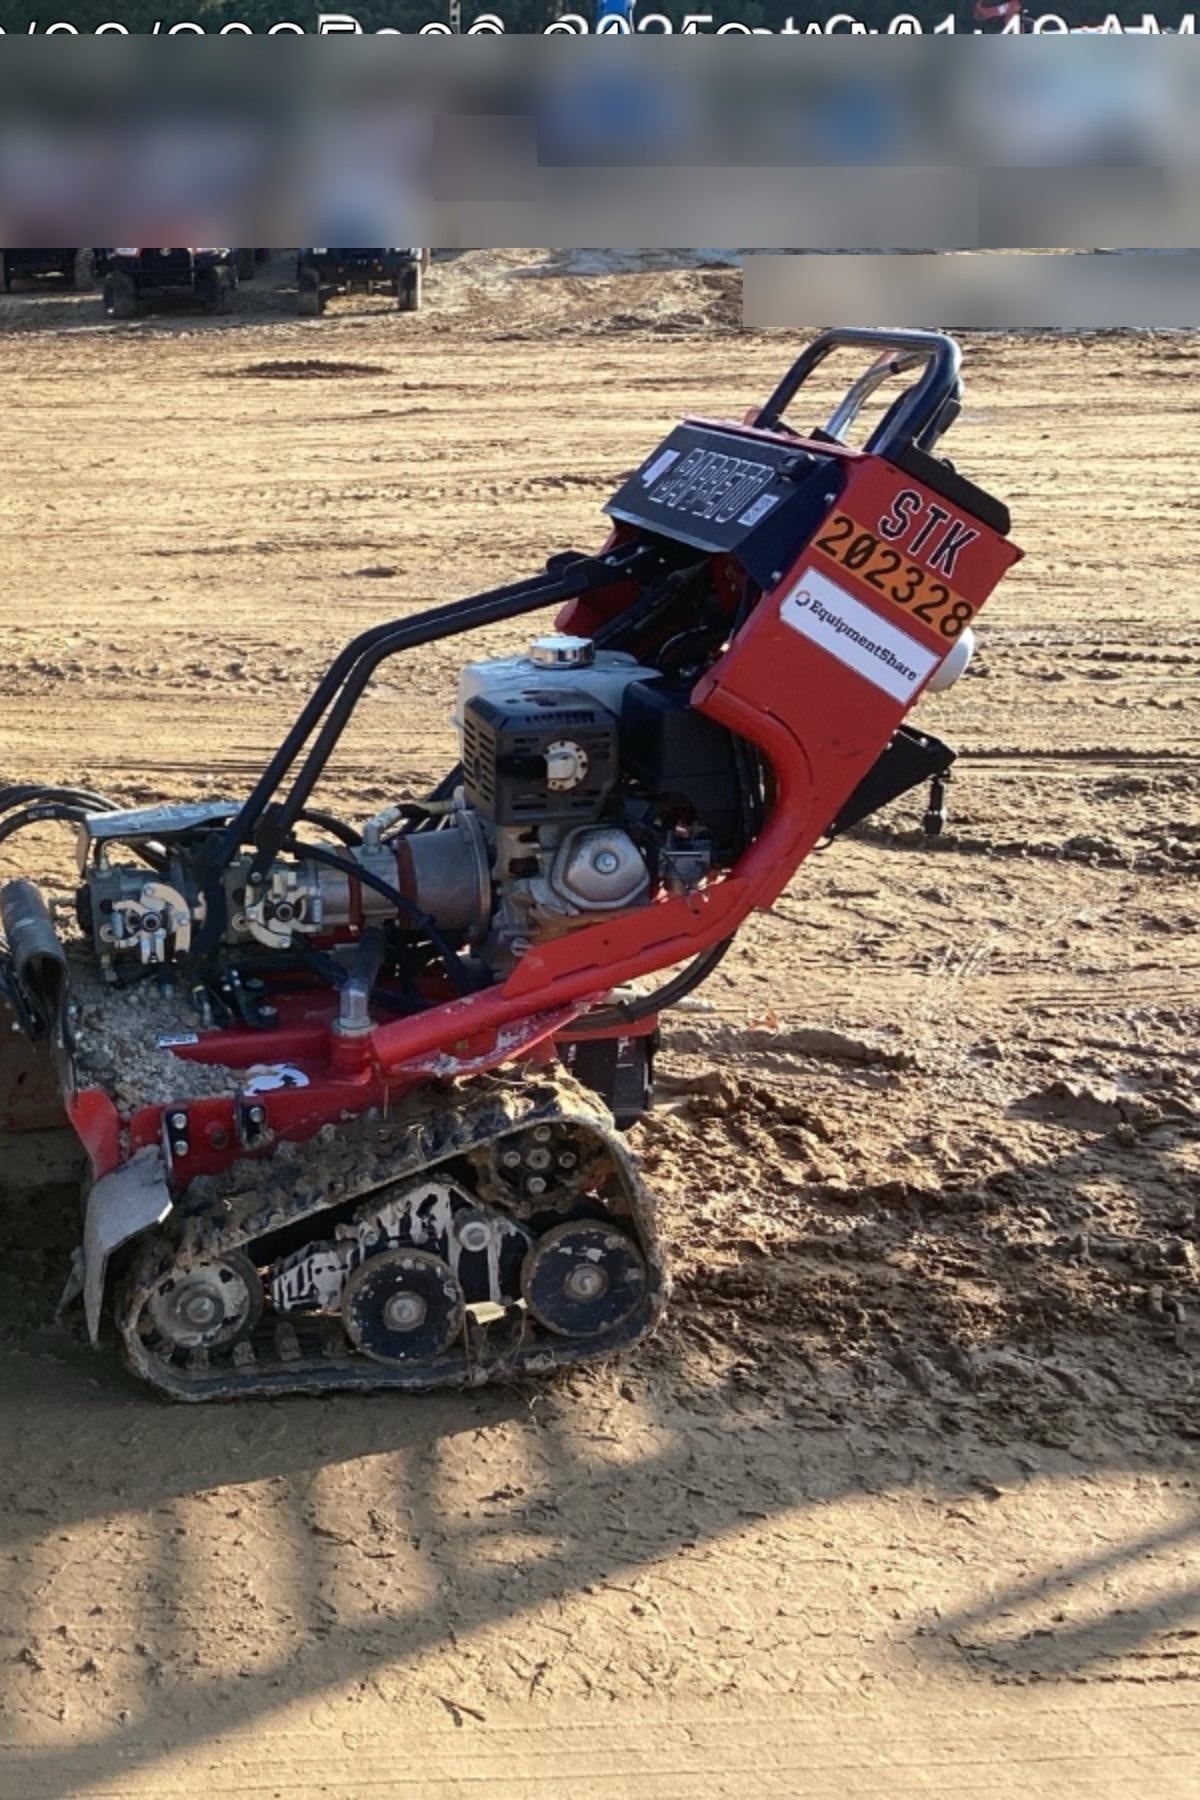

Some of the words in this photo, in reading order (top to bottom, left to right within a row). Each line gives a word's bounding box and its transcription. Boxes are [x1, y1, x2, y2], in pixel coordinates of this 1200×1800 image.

[814, 515, 974, 638] 202328
[877, 489, 981, 579] STK
[809, 601, 918, 681] EquipmentShare
